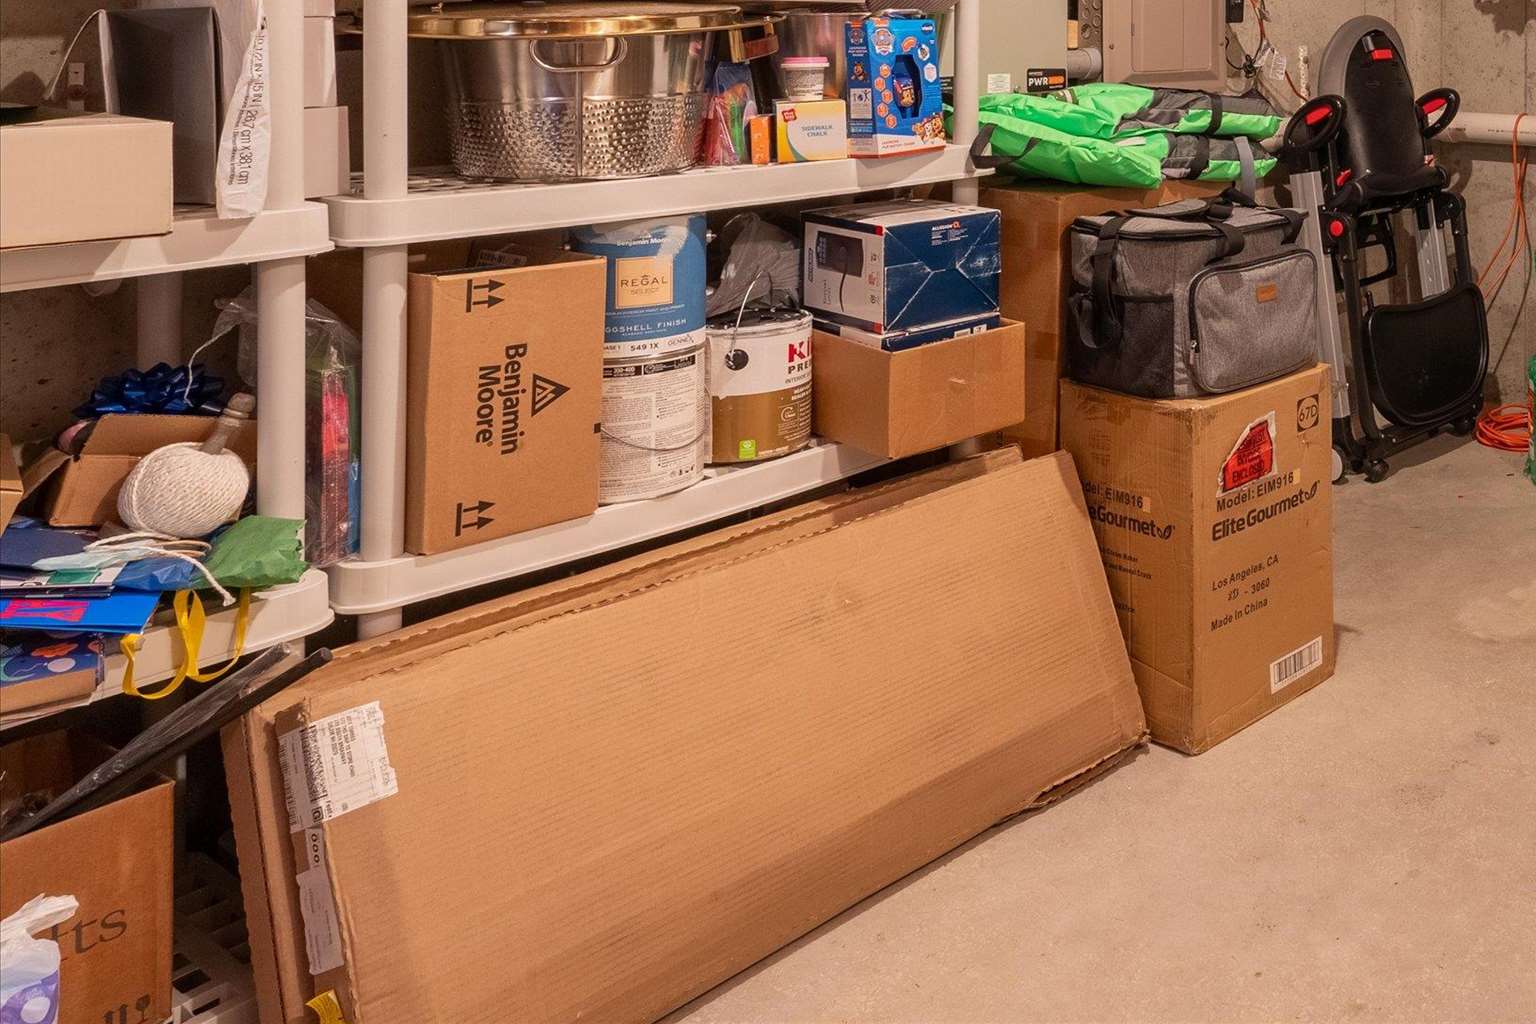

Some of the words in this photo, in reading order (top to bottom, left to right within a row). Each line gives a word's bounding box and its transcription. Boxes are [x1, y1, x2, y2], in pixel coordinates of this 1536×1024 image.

[253, 82, 264, 93] 15
[1028, 77, 1048, 87] PWR
[240, 129, 252, 146] cm
[237, 172, 249, 185] cm
[620, 276, 668, 288] REGAL
[631, 287, 660, 296] SELECT
[604, 323, 652, 334] GGSHELL
[658, 319, 687, 329] FINISH
[650, 342, 660, 350] 1X
[476, 364, 502, 444] Moore
[497, 343, 528, 456] Benjamin
[1105, 487, 1143, 509] EIM916
[1216, 489, 1255, 513] Model:
[1257, 474, 1294, 498] EIM916
[1089, 505, 1156, 538] eGourmet
[1212, 579, 1228, 592] Los
[1228, 561, 1264, 585] Angeles,
[1267, 554, 1279, 566] CA
[1251, 577, 1270, 594] 3060
[1211, 612, 1233, 632] Made
[1244, 598, 1268, 616] China
